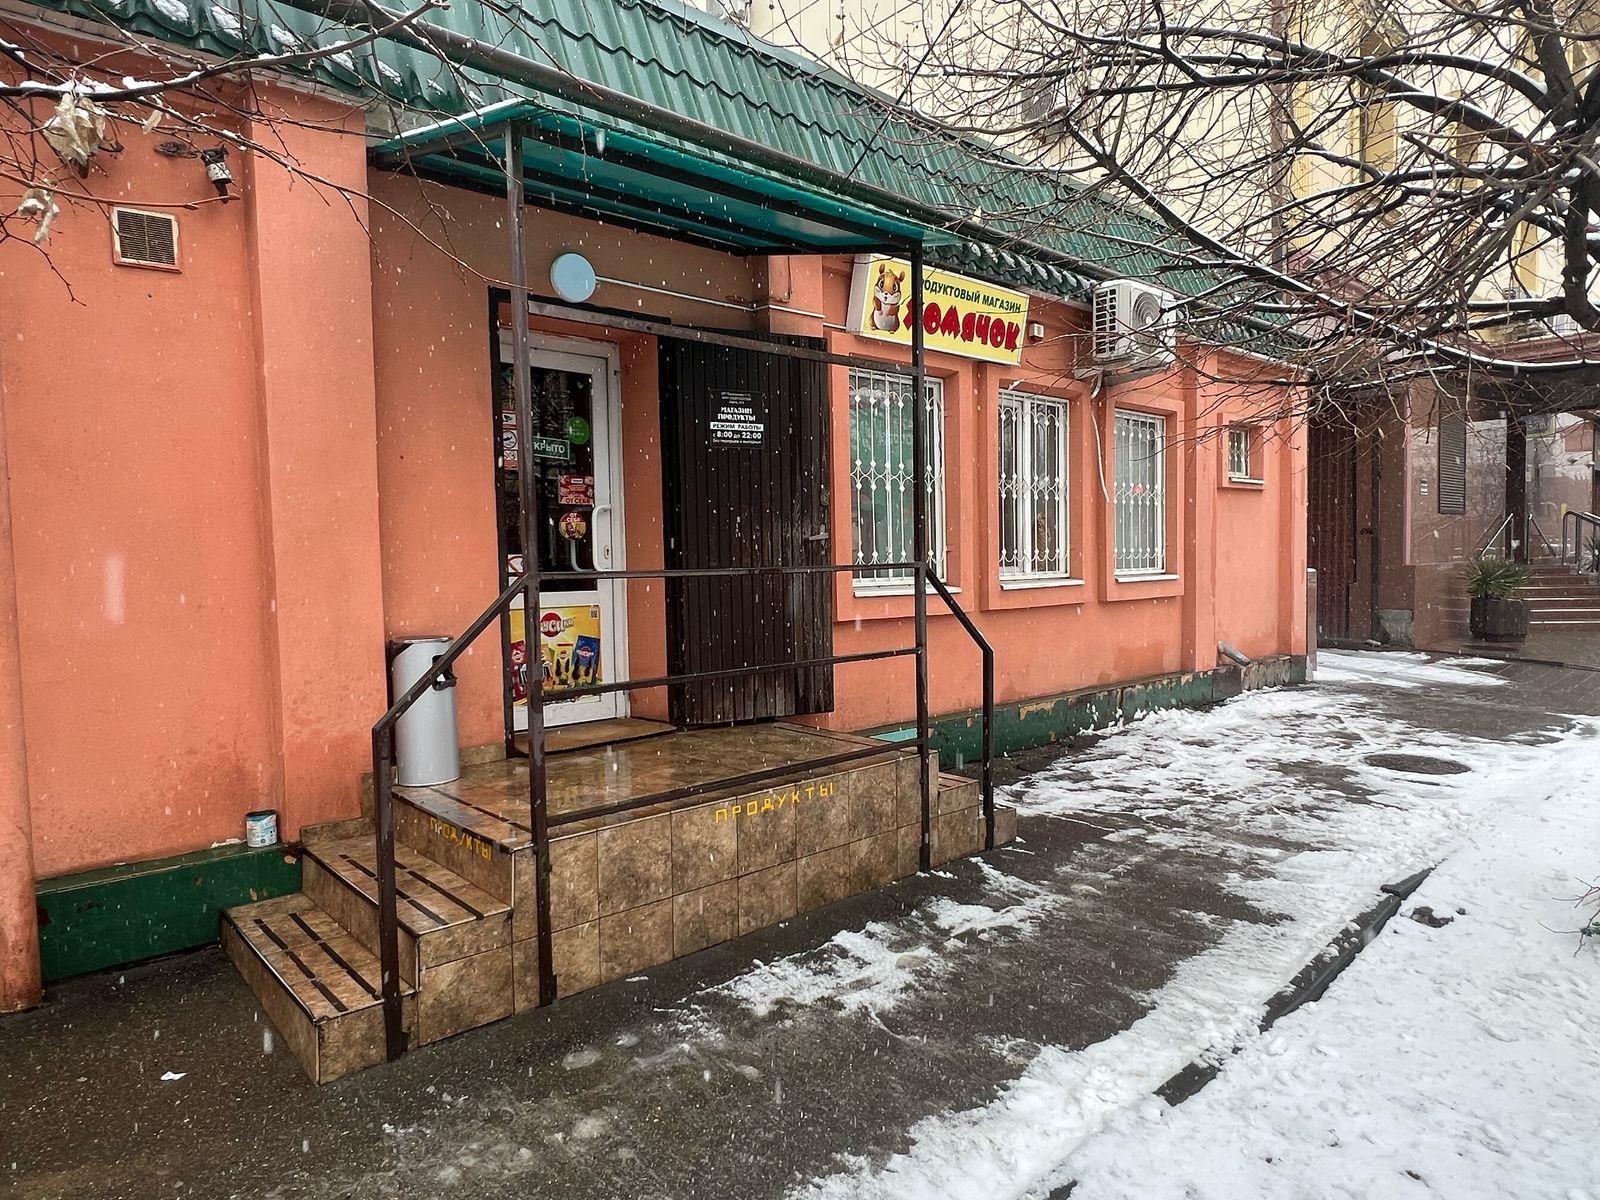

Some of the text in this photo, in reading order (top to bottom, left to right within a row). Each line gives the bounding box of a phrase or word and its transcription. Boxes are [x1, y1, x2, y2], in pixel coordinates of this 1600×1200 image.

[921, 278, 1021, 313] ОДУКТОВЫЙ МАГАЗИН
[720, 406, 752, 414] МАГАЗИН
[717, 413, 756, 421] ПРОДУКТЫ
[533, 440, 565, 453] КРЫТО
[715, 781, 834, 823] ПРОДУКТЫ
